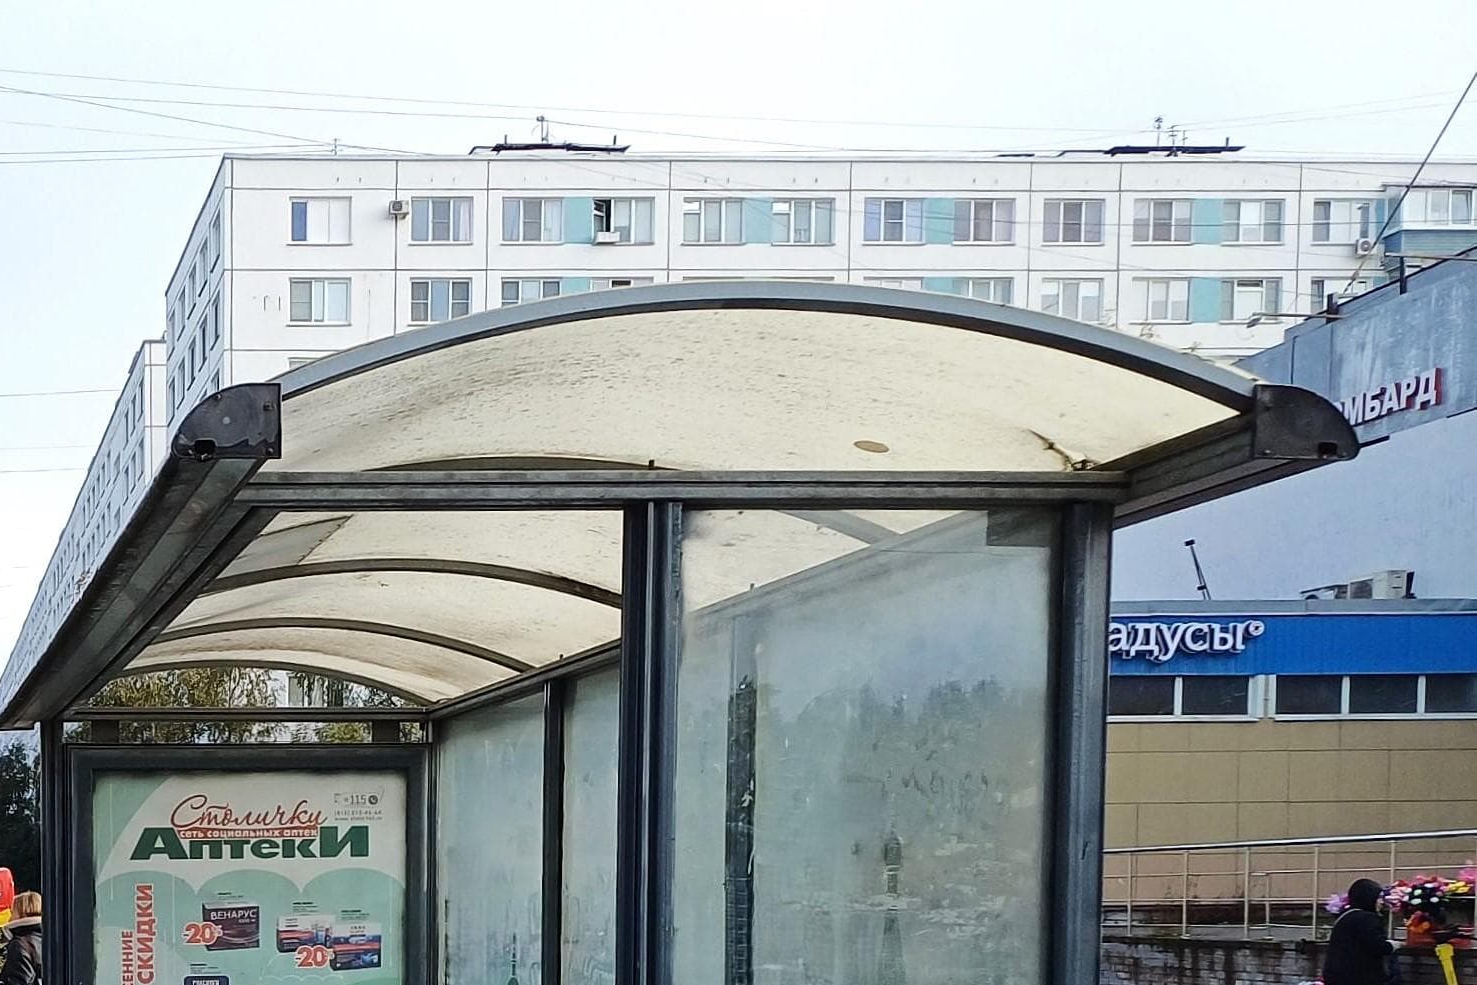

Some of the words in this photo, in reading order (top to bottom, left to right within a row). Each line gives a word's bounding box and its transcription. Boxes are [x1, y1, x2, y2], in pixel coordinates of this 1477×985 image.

[1334, 367, 1442, 425] МБАРД
[170, 794, 328, 828] Столички
[180, 830, 204, 838] сеть
[207, 830, 281, 838] социальных
[283, 829, 318, 837] аптек
[210, 909, 258, 920] ВЕНАРУС
[136, 884, 156, 985] СКИДКИ
